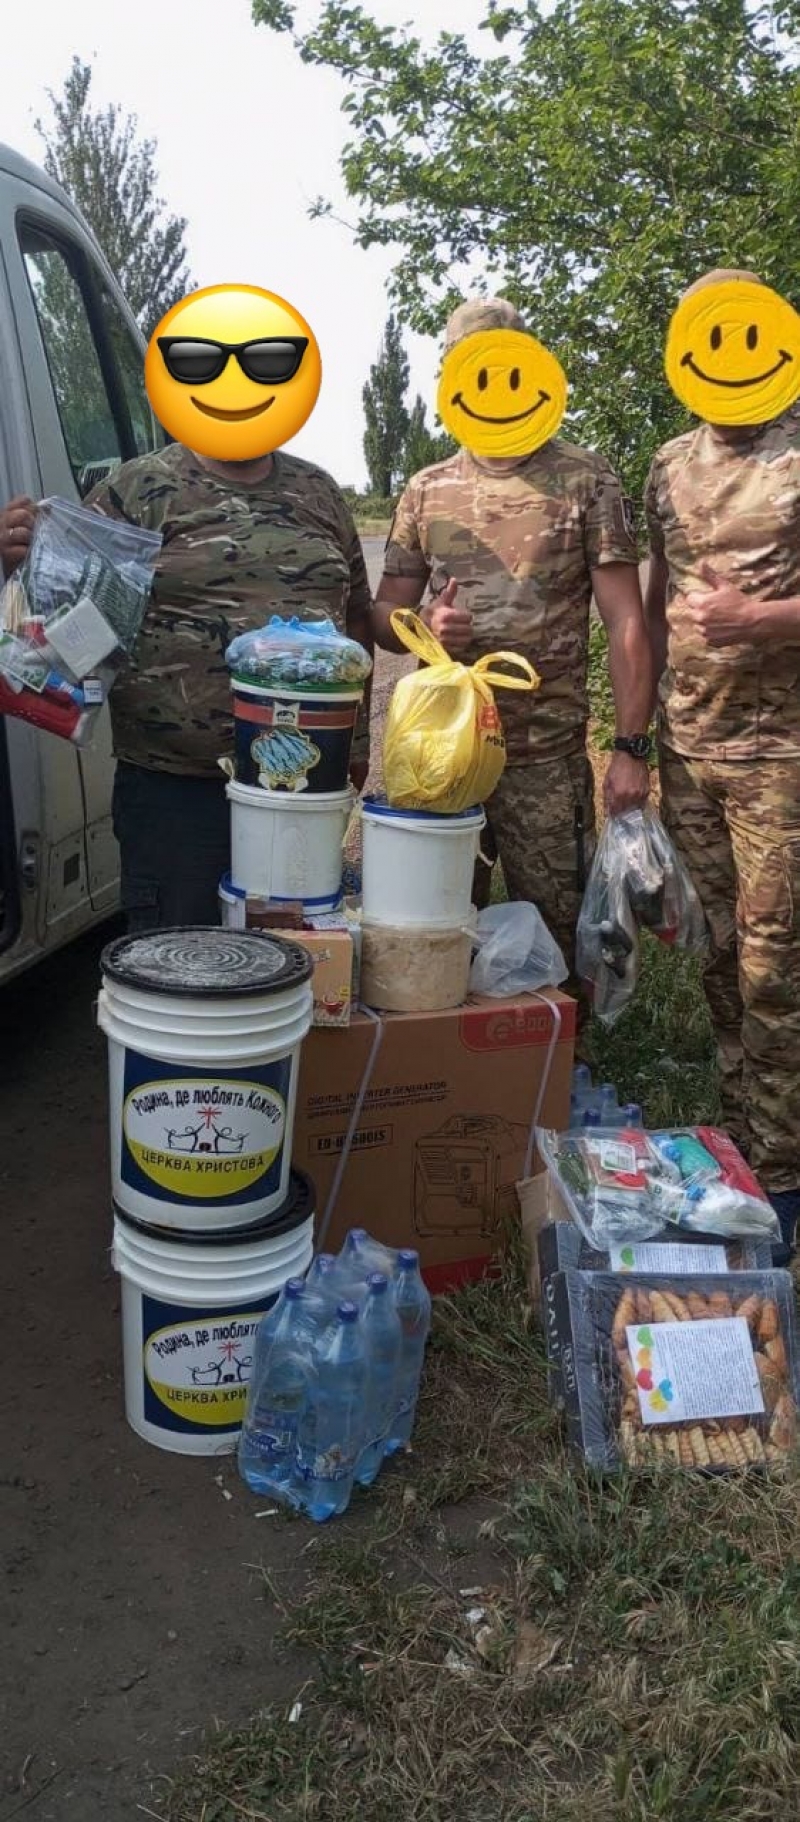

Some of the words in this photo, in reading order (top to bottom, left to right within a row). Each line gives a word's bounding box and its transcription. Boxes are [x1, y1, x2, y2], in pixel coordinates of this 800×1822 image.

[132, 1089, 175, 1116] Родина,
[175, 1088, 190, 1108] де
[192, 1085, 243, 1107] люблять
[245, 1088, 282, 1125] Кожного
[141, 1150, 191, 1173] ЦЕРКВА
[196, 1154, 265, 1174] ХРИСТОВА
[152, 1332, 195, 1359] Родина,
[195, 1328, 209, 1347] де
[167, 1388, 218, 1404] ЦЕРКВА
